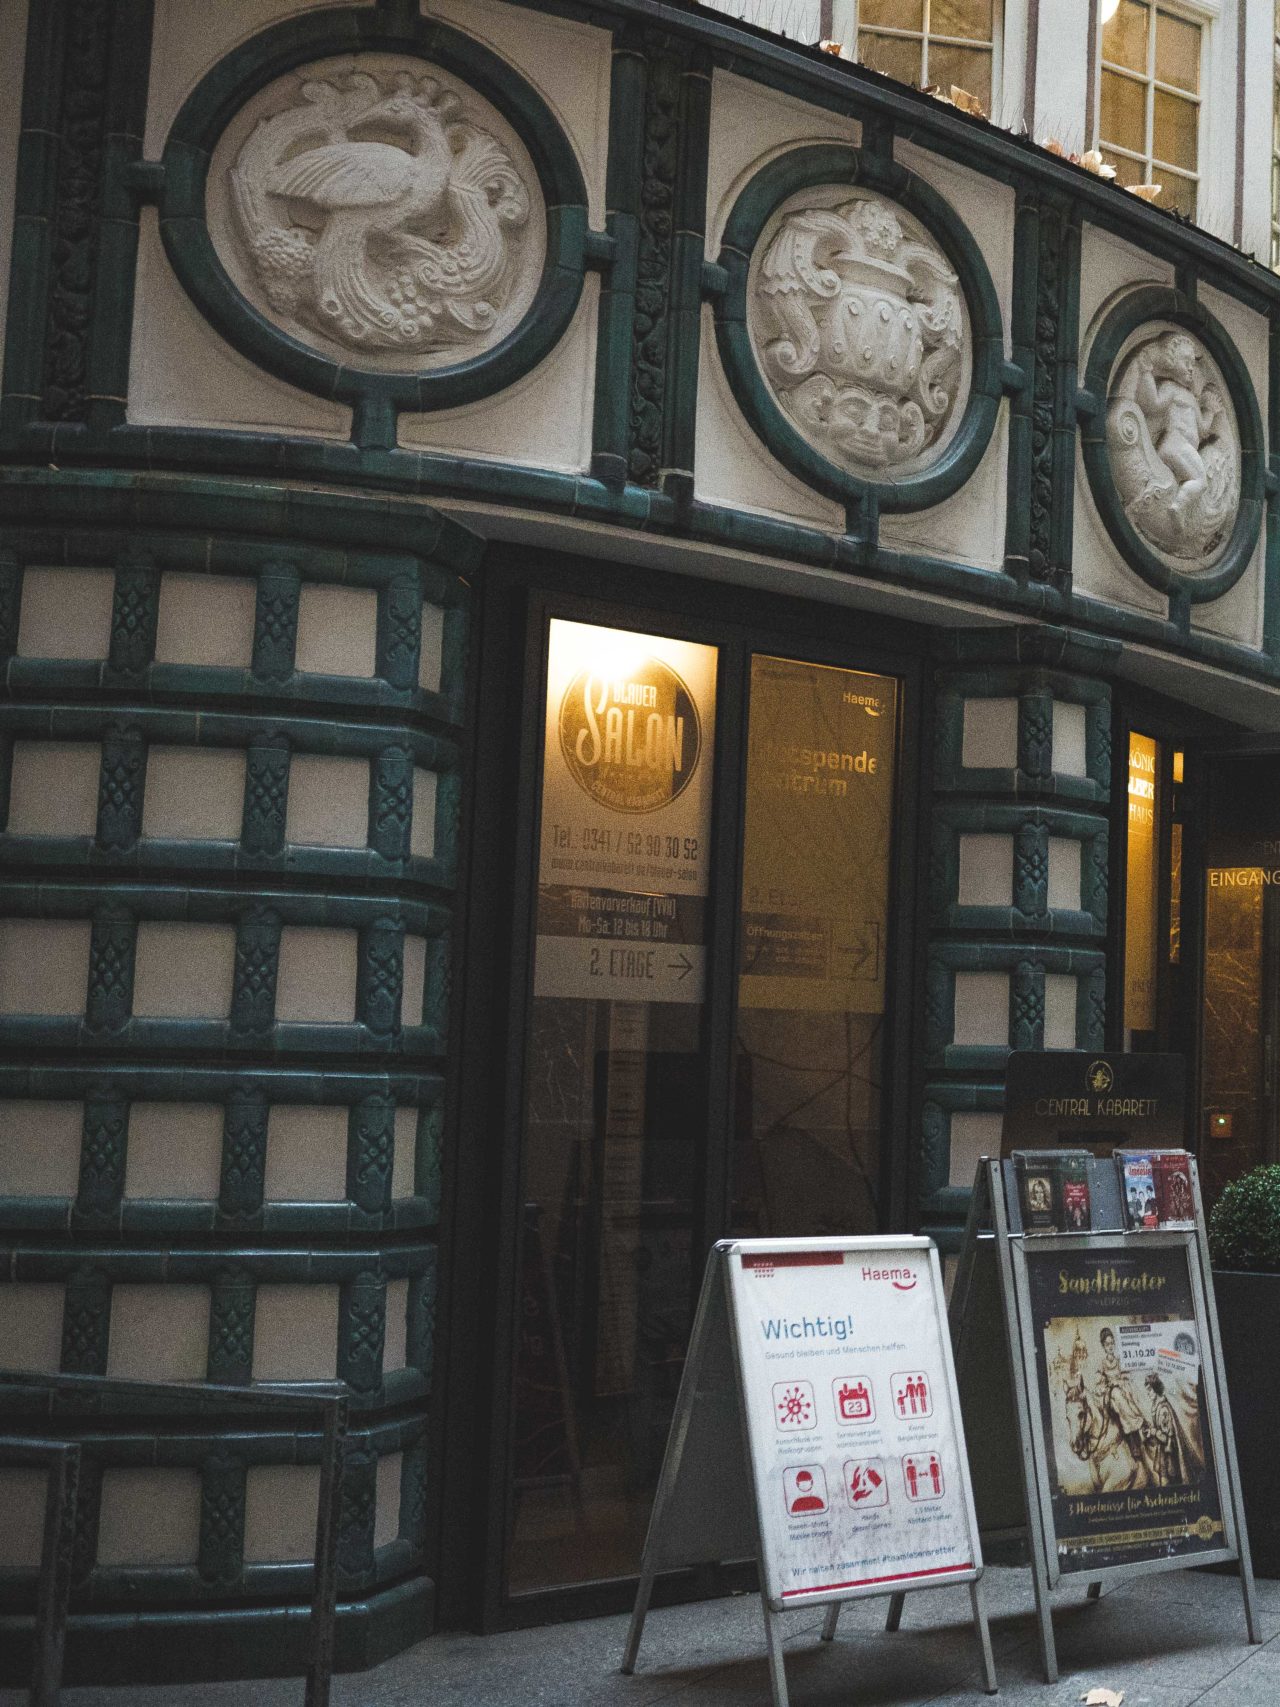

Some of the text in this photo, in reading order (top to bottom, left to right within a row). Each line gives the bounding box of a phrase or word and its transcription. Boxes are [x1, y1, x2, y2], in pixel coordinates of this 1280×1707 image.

[646, 834, 661, 857] 90
[665, 836, 680, 859] 30
[684, 838, 698, 861] 52
[590, 948, 656, 980] 2. ETAGE
[1035, 1098, 1159, 1117] CENTRAL KABARETT
[1058, 1268, 1167, 1295] Sandtheater
[761, 1314, 855, 1341] Wichtig!
[826, 1345, 841, 1356] und
[842, 1343, 881, 1355] Menschen
[847, 1401, 863, 1413] 23
